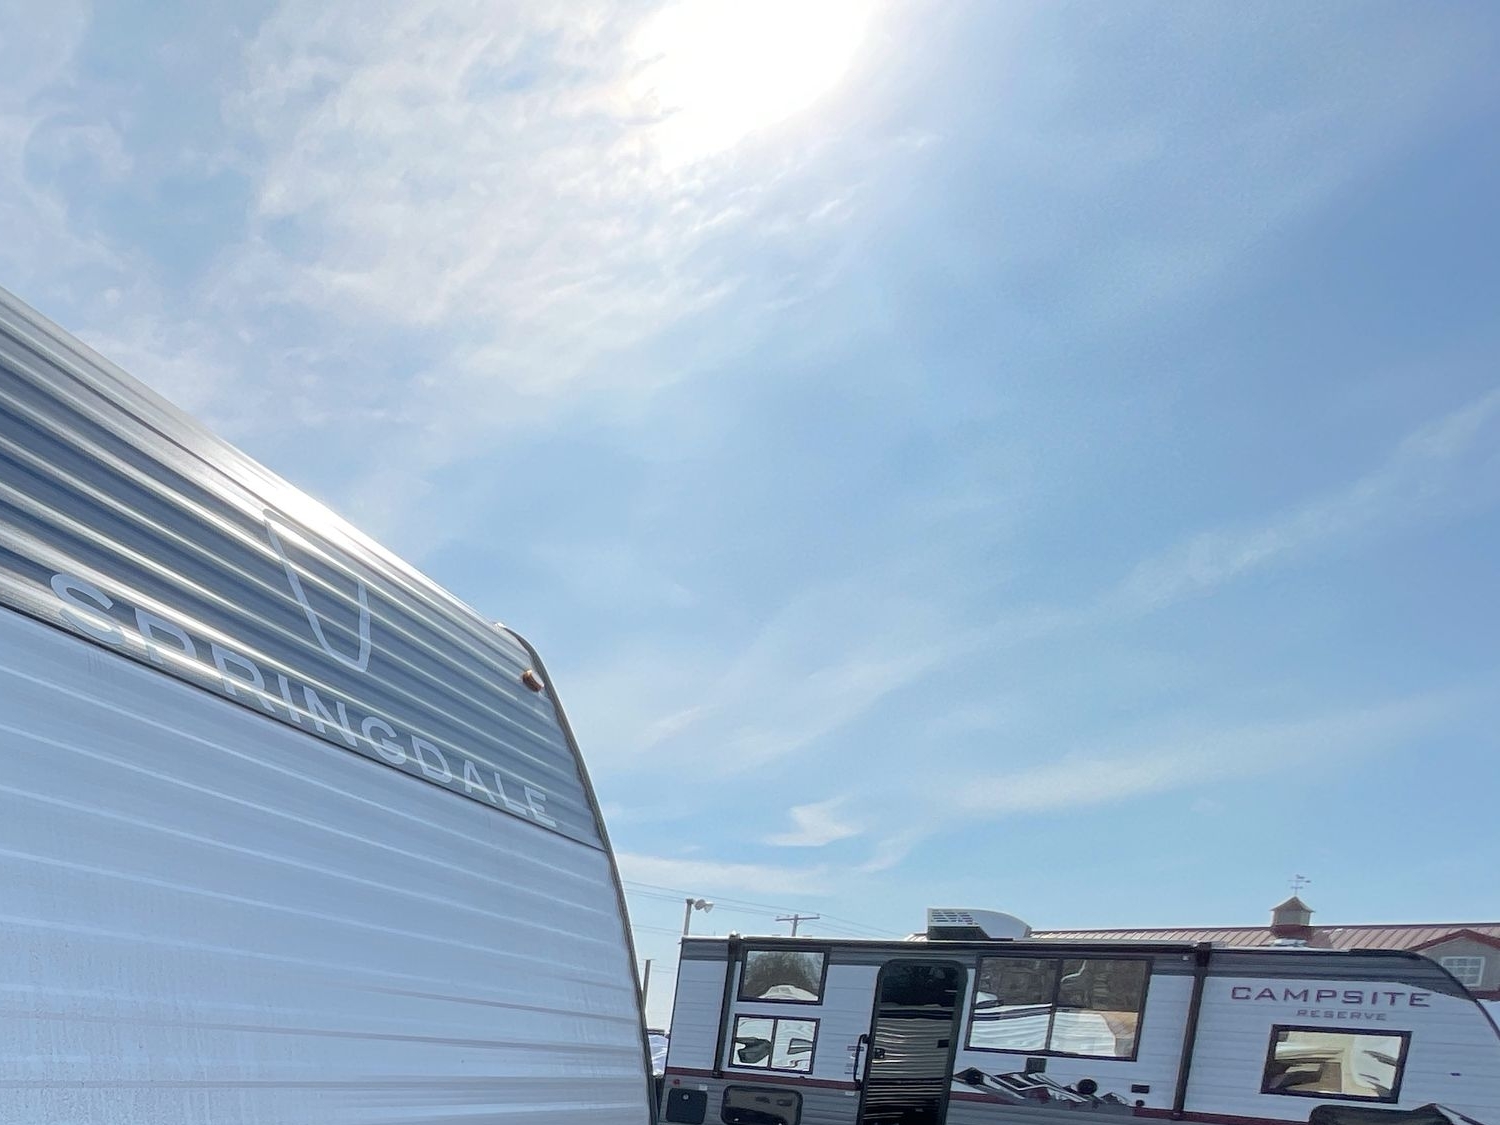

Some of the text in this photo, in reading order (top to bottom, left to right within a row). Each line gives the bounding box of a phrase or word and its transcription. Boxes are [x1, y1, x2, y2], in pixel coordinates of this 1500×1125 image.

[49, 572, 558, 829] SPRINGDALE
[1231, 986, 1433, 1008] CAMPSITE
[1296, 1009, 1387, 1021] RESERVE
